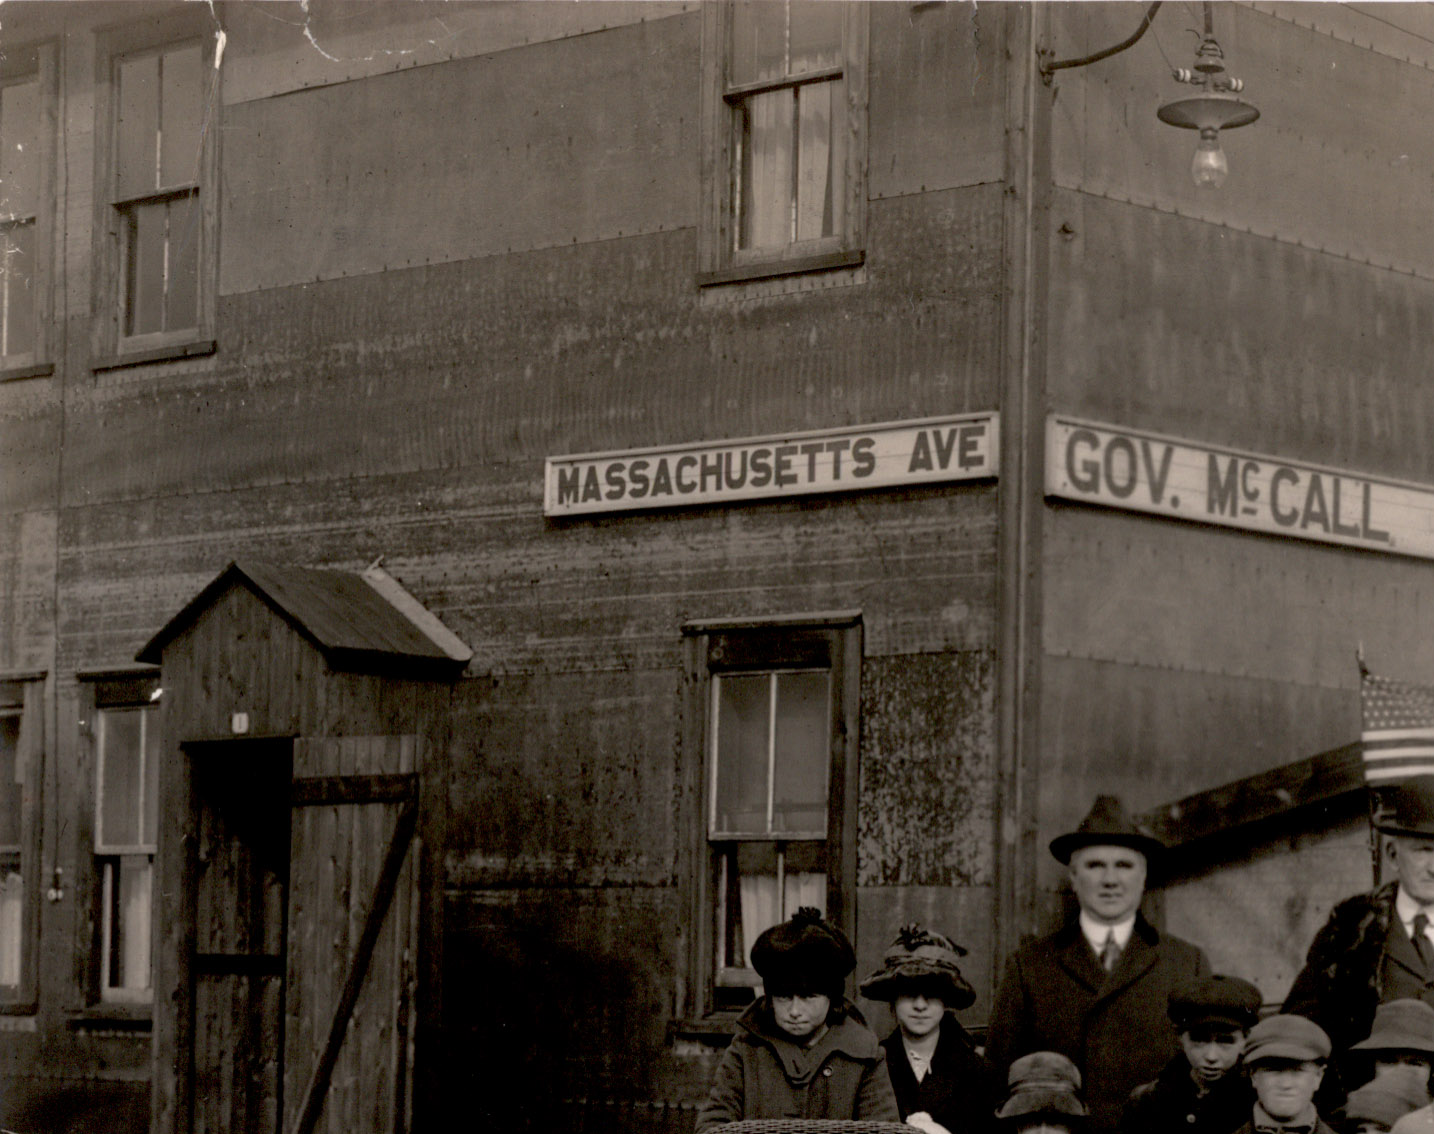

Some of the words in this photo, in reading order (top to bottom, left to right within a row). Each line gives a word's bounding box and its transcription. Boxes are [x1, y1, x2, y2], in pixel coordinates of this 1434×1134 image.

[557, 437, 877, 506] MASSACHUSETTS
[908, 425, 986, 474] AVE
[1065, 429, 1180, 509] GOV.
